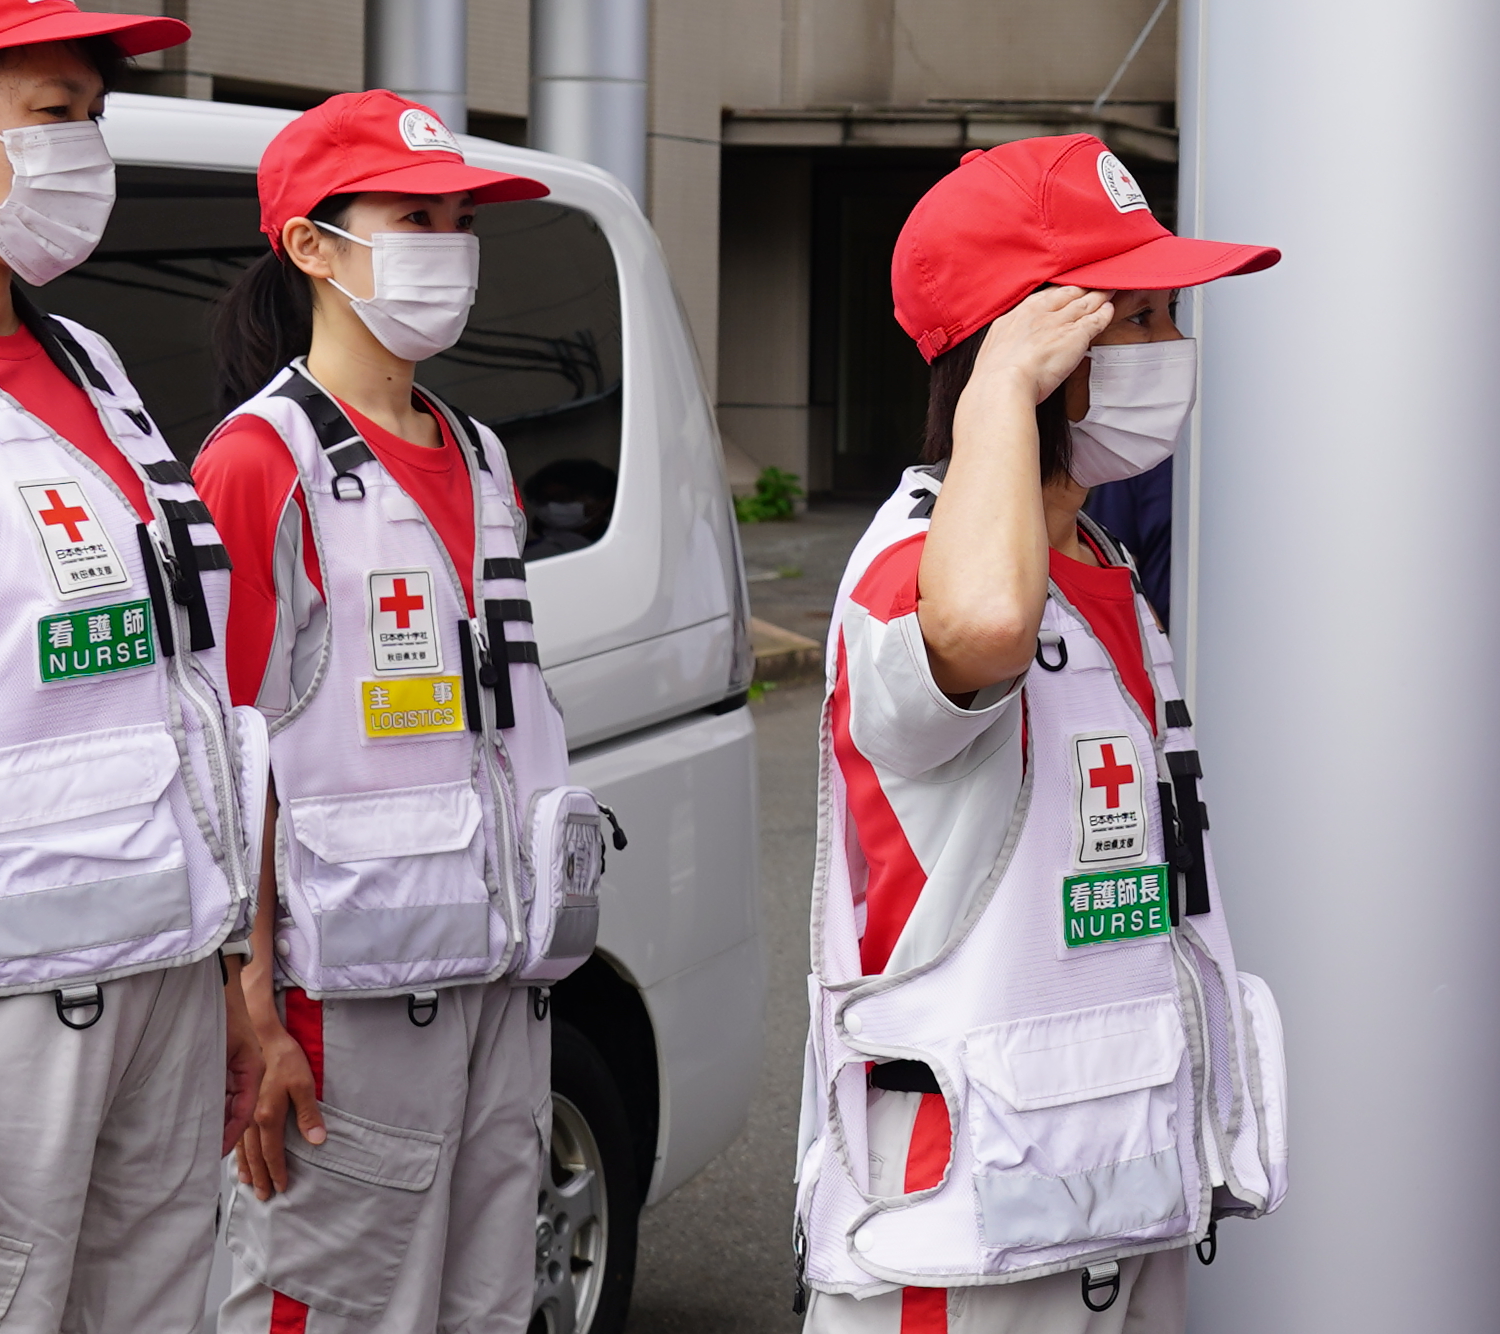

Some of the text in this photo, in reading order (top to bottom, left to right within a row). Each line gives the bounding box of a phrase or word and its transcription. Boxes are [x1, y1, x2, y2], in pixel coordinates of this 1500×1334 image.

[48, 608, 144, 648] 看護師
[50, 639, 148, 673] NURSE
[371, 708, 455, 730] LOGISTICS
[1070, 875, 1161, 912] 看護師長
[1071, 907, 1162, 939] NURSE
